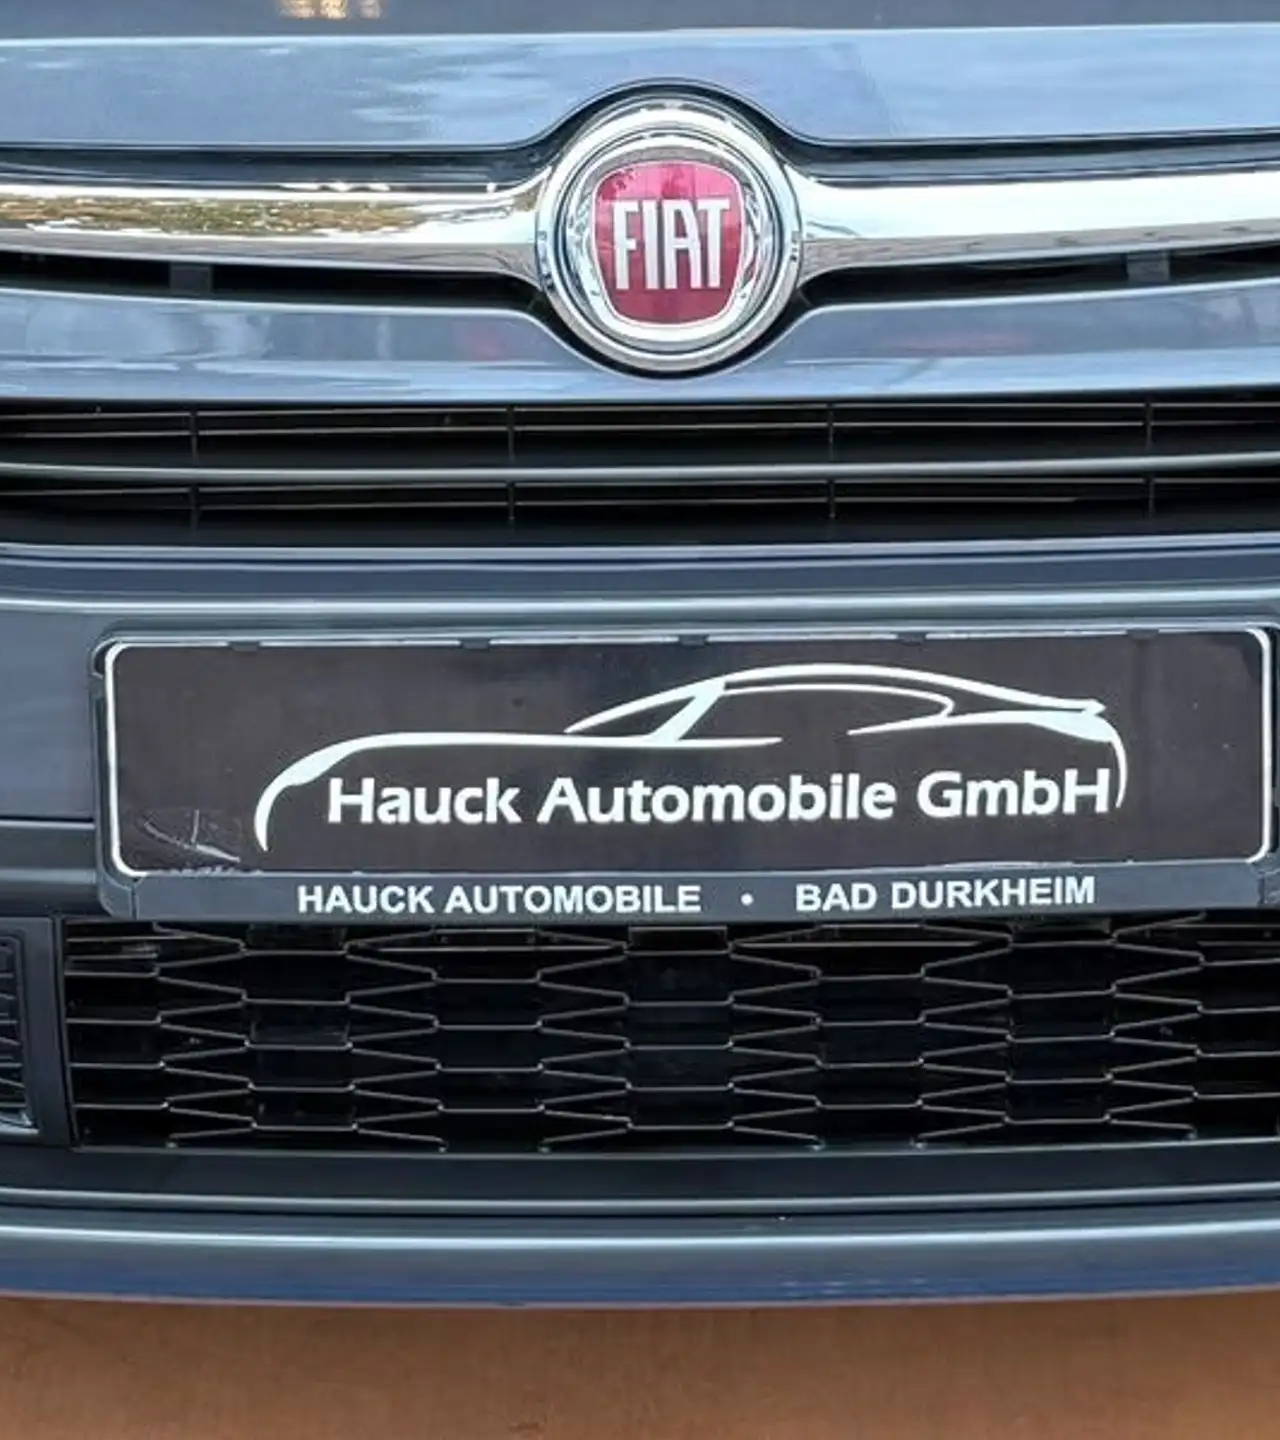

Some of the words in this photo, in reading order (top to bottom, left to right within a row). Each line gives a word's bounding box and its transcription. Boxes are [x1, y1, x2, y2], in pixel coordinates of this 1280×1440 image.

[613, 199, 730, 290] FIAT
[326, 776, 522, 825] Hauck
[536, 772, 897, 824] Automobile
[916, 767, 1111, 819] GmbH
[297, 885, 435, 914] HAUCK
[443, 884, 702, 914] AUTOMOBILE
[795, 882, 878, 912] BAD
[890, 875, 1095, 910] DURKHEIM
